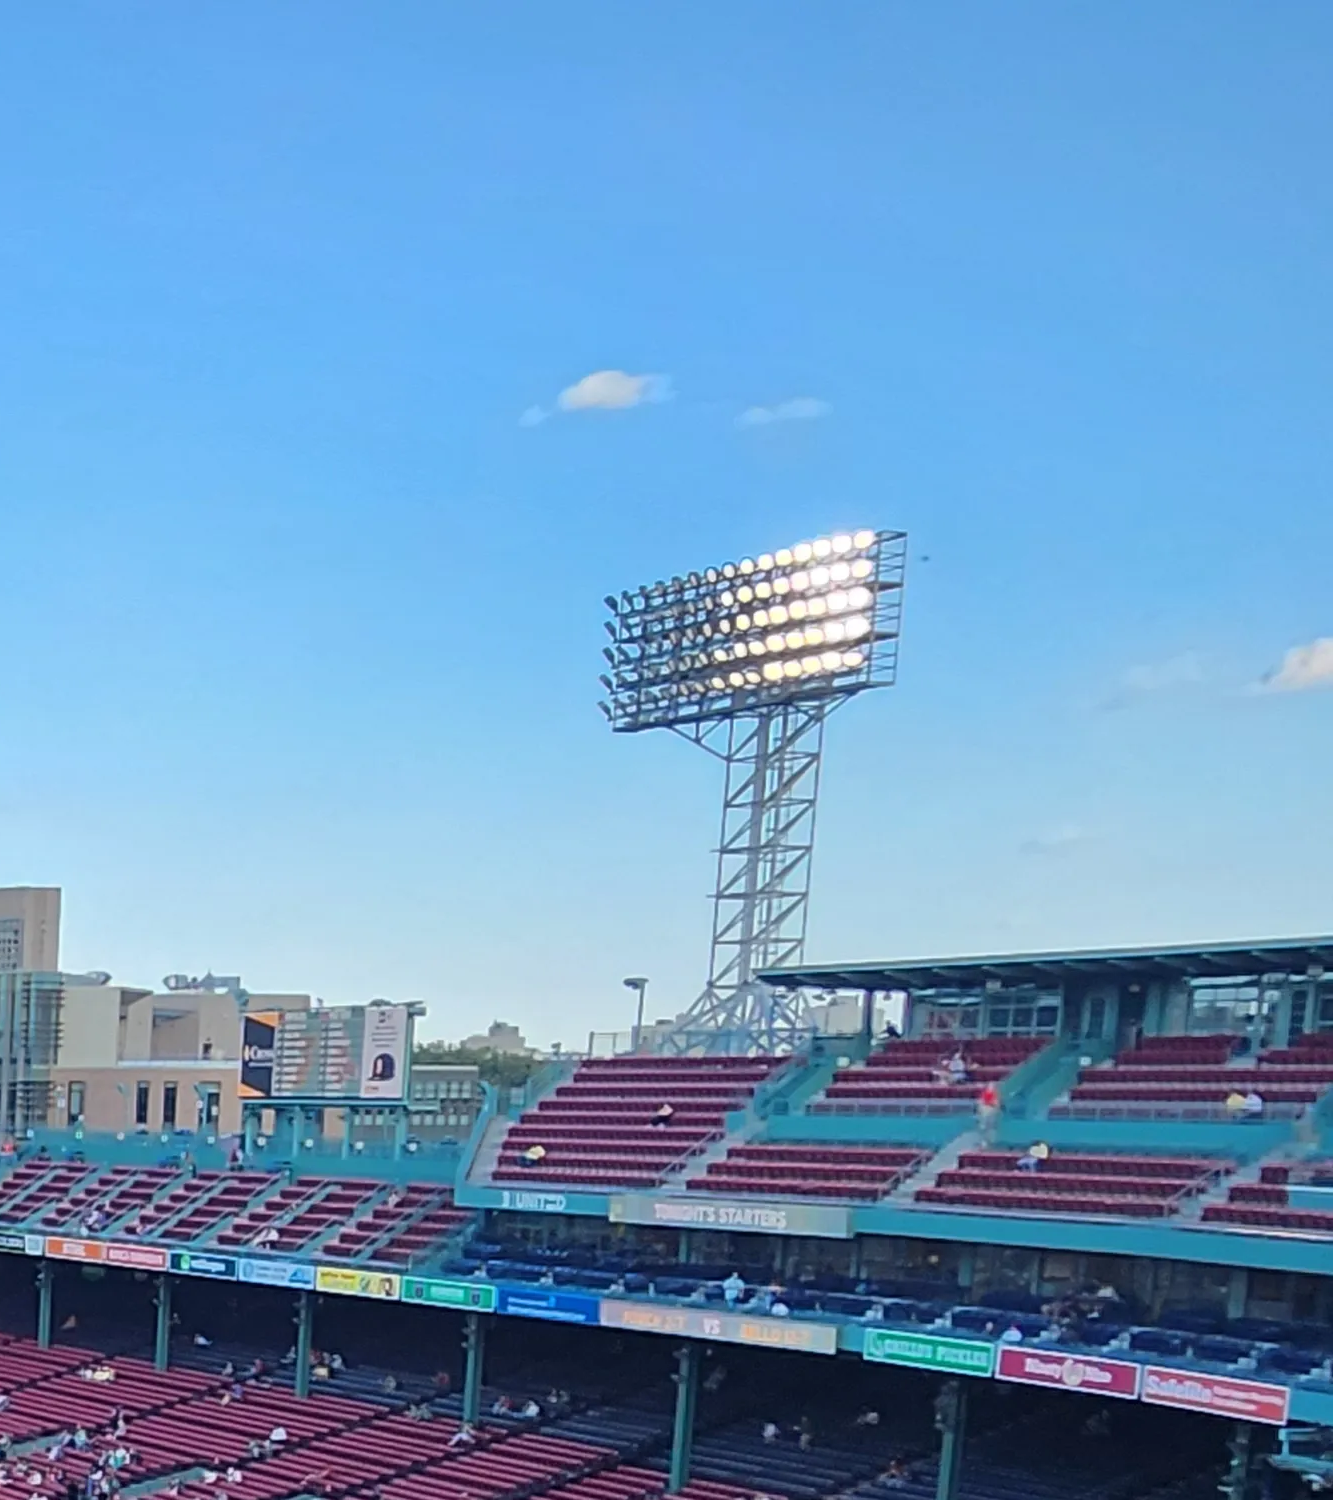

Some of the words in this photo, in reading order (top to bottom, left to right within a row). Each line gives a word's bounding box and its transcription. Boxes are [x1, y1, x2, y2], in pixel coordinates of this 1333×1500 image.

[516, 1192, 566, 1211] UNITED
[718, 1204, 787, 1229] STARTERS
[702, 1317, 722, 1335] VS
